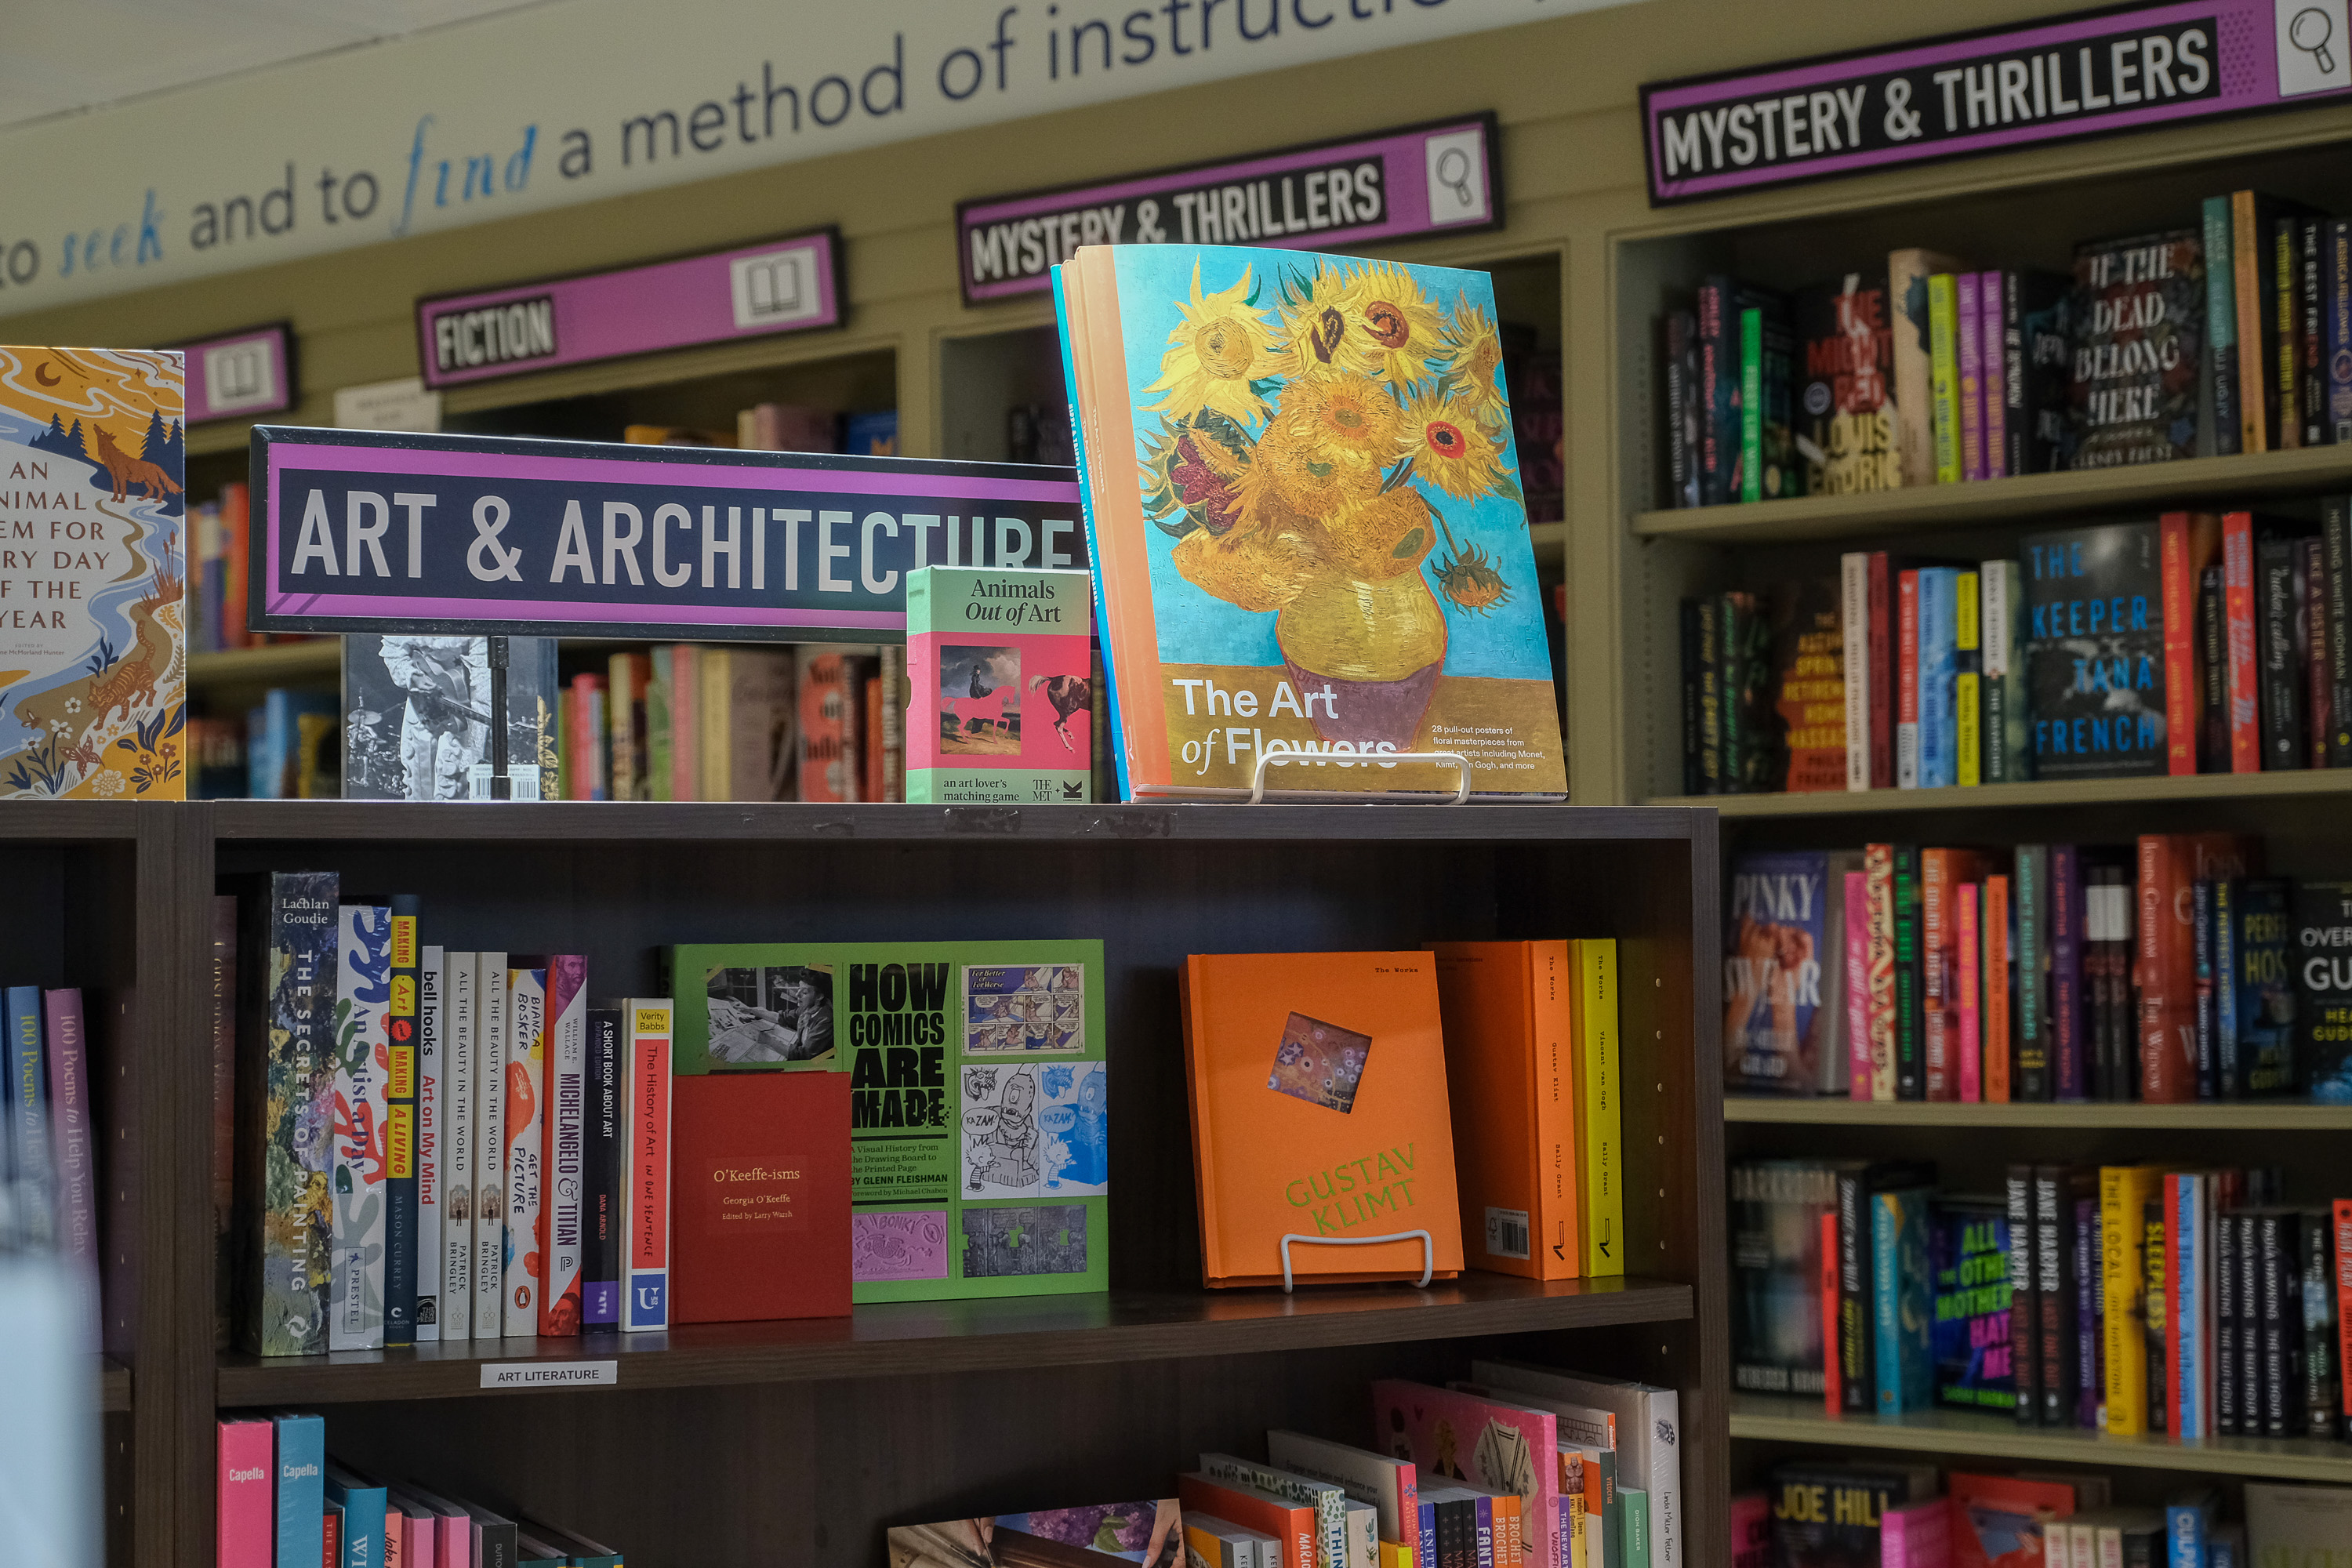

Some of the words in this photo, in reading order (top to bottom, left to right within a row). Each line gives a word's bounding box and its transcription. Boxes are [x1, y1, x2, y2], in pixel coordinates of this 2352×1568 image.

[1661, 85, 1867, 176] MYSTERY
[1882, 78, 1922, 142] &
[1933, 29, 2211, 132] THRILLERS
[59, 189, 163, 277] seek
[190, 162, 296, 250] and
[317, 167, 379, 224] to
[394, 114, 538, 236] find
[558, 129, 593, 179] a
[620, 33, 904, 165] method
[937, 6, 1018, 101] of
[968, 206, 1126, 282] MYSTERY
[1173, 162, 1381, 244] THRILLERS
[2305, 223, 2318, 256] THE
[2089, 255, 2111, 289] IF
[2122, 244, 2175, 285] THE
[2304, 260, 2318, 302] BEST
[2093, 291, 2165, 335] DEAD
[435, 301, 553, 372] FICTION
[2305, 307, 2319, 368] FRIEND
[2074, 336, 2180, 383] BELONG
[2086, 383, 2161, 426] HERE
[9, 462, 48, 481] AN
[50, 521, 105, 540] FOR
[291, 488, 437, 580] ART
[466, 495, 524, 583] &
[548, 499, 1076, 595] ARCHITECTURE
[2328, 508, 2343, 569] MISSING
[54, 551, 111, 570] DAY
[2031, 542, 2085, 580] THE
[2309, 543, 2324, 581] LIKE
[27, 581, 82, 599] THE
[971, 579, 1055, 600] Animals
[2332, 572, 2346, 617] WHITE
[966, 602, 1002, 621] Out
[1006, 602, 1029, 626] of
[1029, 604, 1062, 622] Art
[2032, 595, 2149, 639] KEEPER
[2311, 602, 2326, 661] SISTER
[2333, 619, 2347, 681] WOMAN
[2073, 655, 2154, 693] TANA
[1171, 678, 1258, 717] The
[1268, 681, 1339, 720] Art
[1181, 728, 1221, 775] of
[1225, 727, 1397, 768] Flowers
[1444, 725, 1474, 735] pull-out
[1475, 727, 1504, 735] posters
[1454, 738, 1505, 746] masterpieces
[2035, 715, 2156, 755] FRENCH
[1475, 760, 1499, 770] Gogh,
[1482, 750, 1517, 759] including
[1519, 750, 1545, 759] Monet,
[944, 780, 956, 789] an
[958, 779, 973, 788] art
[944, 791, 991, 803] matching
[993, 793, 1020, 804] game
[1033, 779, 1052, 789] THE
[1033, 790, 1053, 801] MET
[282, 898, 329, 909] Lachlan
[283, 912, 328, 924] Goudie
[1733, 873, 1820, 922] PINKY
[397, 920, 409, 964] MAKING
[297, 950, 312, 997] THE
[423, 971, 437, 1001] bell
[848, 963, 949, 1012] HOW
[397, 984, 410, 1011] Art
[641, 1012, 665, 1022] Verity
[353, 1004, 372, 1035] An
[423, 1006, 437, 1056] hooks
[517, 993, 528, 1051] BOSKER
[530, 996, 541, 1047] BIANCA
[640, 1022, 665, 1031] Babbs
[849, 1012, 945, 1047] COMICS
[294, 1009, 311, 1116] SECRETS
[458, 1027, 467, 1076] BEAUTY
[490, 1027, 499, 1076] BEAUTY
[603, 1030, 613, 1060] SHORT
[647, 1046, 658, 1070] The
[2148, 1030, 2165, 1093] WIDOW
[22, 1051, 39, 1108] Poems
[62, 1050, 80, 1105] Poems
[394, 1051, 407, 1094] MAKING
[422, 1075, 436, 1102] Art
[603, 1062, 613, 1085] BOOK
[851, 1047, 945, 1089] ARE
[422, 1106, 434, 1127] on
[603, 1087, 613, 1120] ABOUT
[644, 1077, 658, 1120] History
[851, 1088, 950, 1129] MADE
[294, 1127, 309, 1158] OF
[557, 1073, 580, 1174] MICHELANGELO
[602, 1120, 613, 1138] ART
[394, 1123, 406, 1174] LIVING
[418, 1133, 435, 1159] My
[456, 1127, 465, 1171] WORLD
[488, 1126, 497, 1171] WORLD
[864, 1155, 900, 1163] Drawing
[884, 1145, 917, 1153] History
[421, 1163, 435, 1206] Mind
[513, 1147, 526, 1215] PICTURE
[713, 1167, 800, 1182] O'Keeffe-isms
[863, 1176, 894, 1185] GLENN
[896, 1174, 948, 1184] FLEISHMAN
[1285, 1142, 1416, 1208] GUSTAV
[723, 1196, 754, 1207] Georgia
[1310, 1178, 1416, 1236] KLIMT
[2009, 1180, 2027, 1221] JANE
[2037, 1180, 2057, 1221] JANE
[291, 1171, 309, 1292] PAINTING
[557, 1203, 578, 1247] TITIAN
[643, 1203, 653, 1258] SENTENCE
[448, 1242, 458, 1294] BRINGLEY
[459, 1245, 467, 1291] PATRICK
[480, 1241, 488, 1294] BRINGLEY
[2009, 1223, 2030, 1292] HARPER
[2038, 1224, 2059, 1292] HARPER
[2107, 1218, 2122, 1283] LOCAL
[2147, 1221, 2167, 1330] SLEEPLESS
[2220, 1258, 2234, 1317] HAWKINS
[2242, 1258, 2257, 1319] HAWKINS
[2265, 1259, 2280, 1320] HAWKINS
[350, 1269, 360, 1325] PRESTEL
[497, 1372, 523, 1382] ART
[524, 1369, 599, 1381] LITERATURE
[2222, 1379, 2234, 1415] HOUR
[2245, 1381, 2258, 1417] HOUR
[2269, 1383, 2282, 1418] HOUR
[228, 1465, 264, 1483] Capella
[283, 1461, 318, 1479] Capella
[1663, 1491, 1672, 1509] Linda
[1773, 1483, 1828, 1523] JOE
[1494, 1516, 1508, 1566] BROCHET
[1508, 1515, 1522, 1565] BROCHET
[1663, 1511, 1674, 1536] Miller
[384, 1532, 397, 1564] Jake
[1664, 1537, 1674, 1563] Feltner
